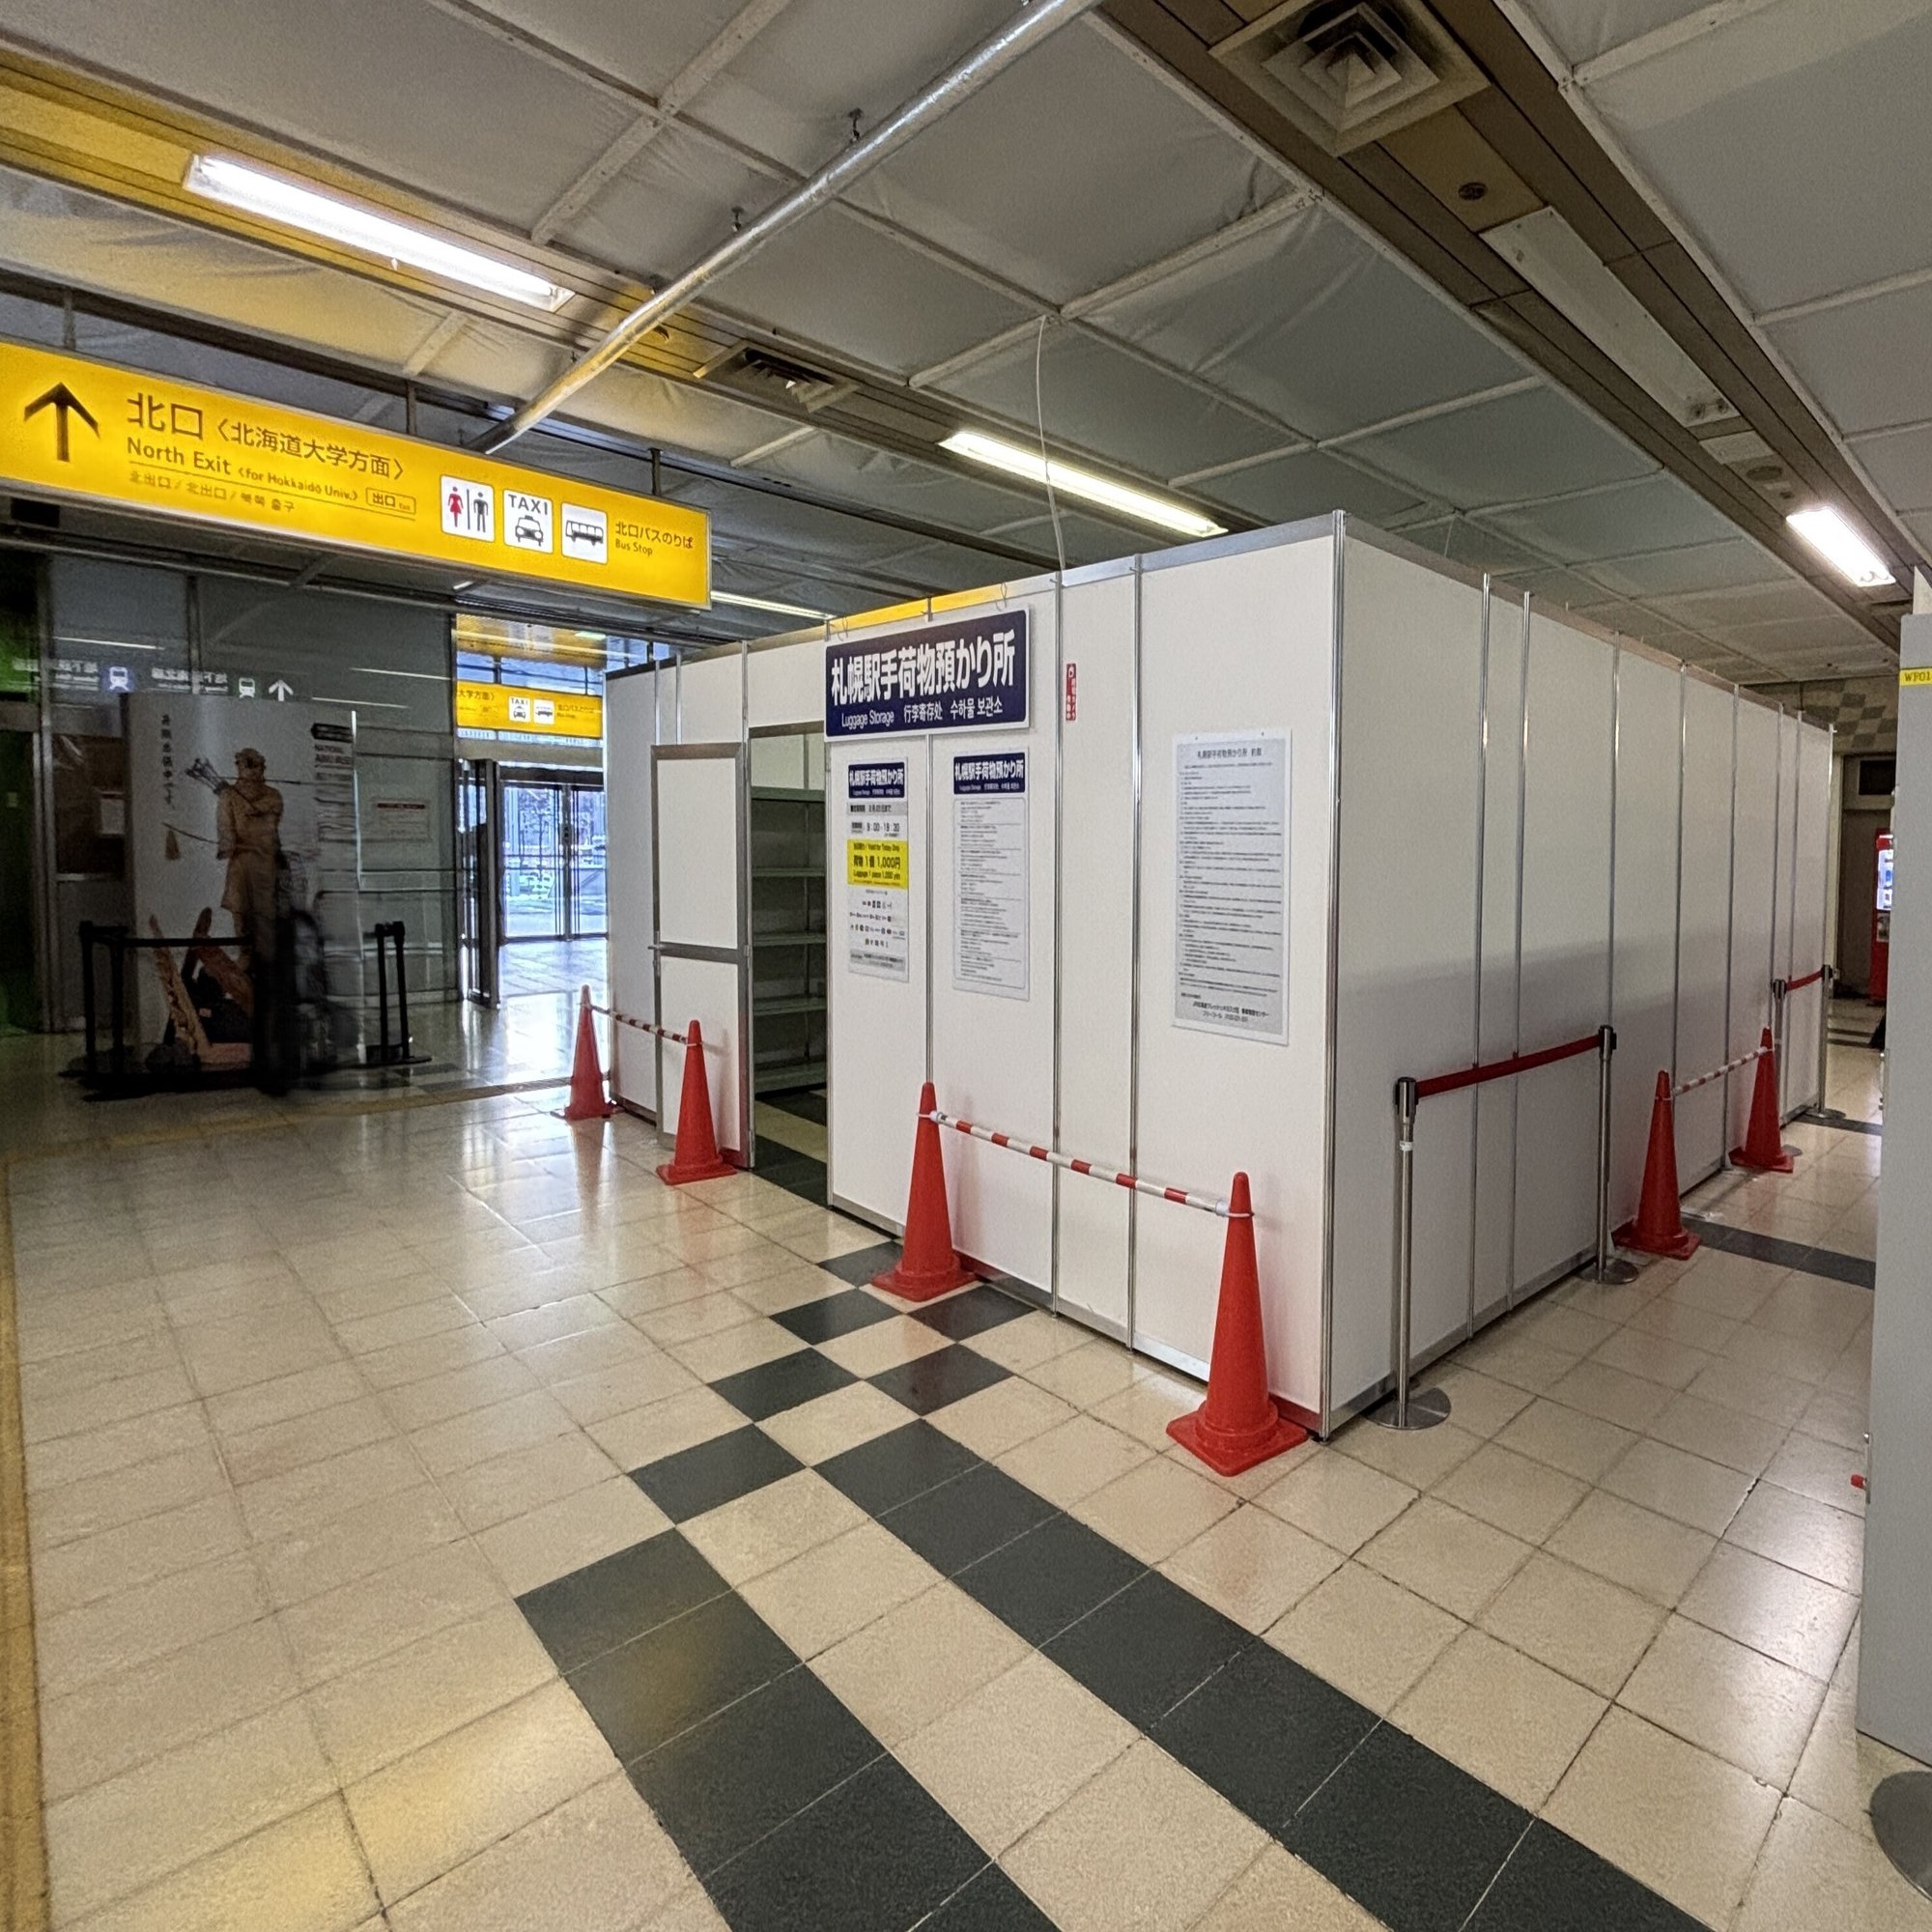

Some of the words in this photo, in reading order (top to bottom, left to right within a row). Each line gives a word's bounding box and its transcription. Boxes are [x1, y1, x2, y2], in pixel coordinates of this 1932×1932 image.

[128, 392, 203, 440] 北口
[128, 437, 185, 466] North
[193, 450, 231, 475] Exit
[373, 493, 396, 507] 出口
[507, 494, 549, 516] TAXI
[614, 521, 695, 551] 北口バスのりば
[614, 539, 630, 553] Bus
[633, 541, 653, 557] Stop
[831, 629, 1015, 706] 札幌駅手荷物預かり所
[841, 711, 868, 730] Luggage
[869, 708, 895, 726] Storage
